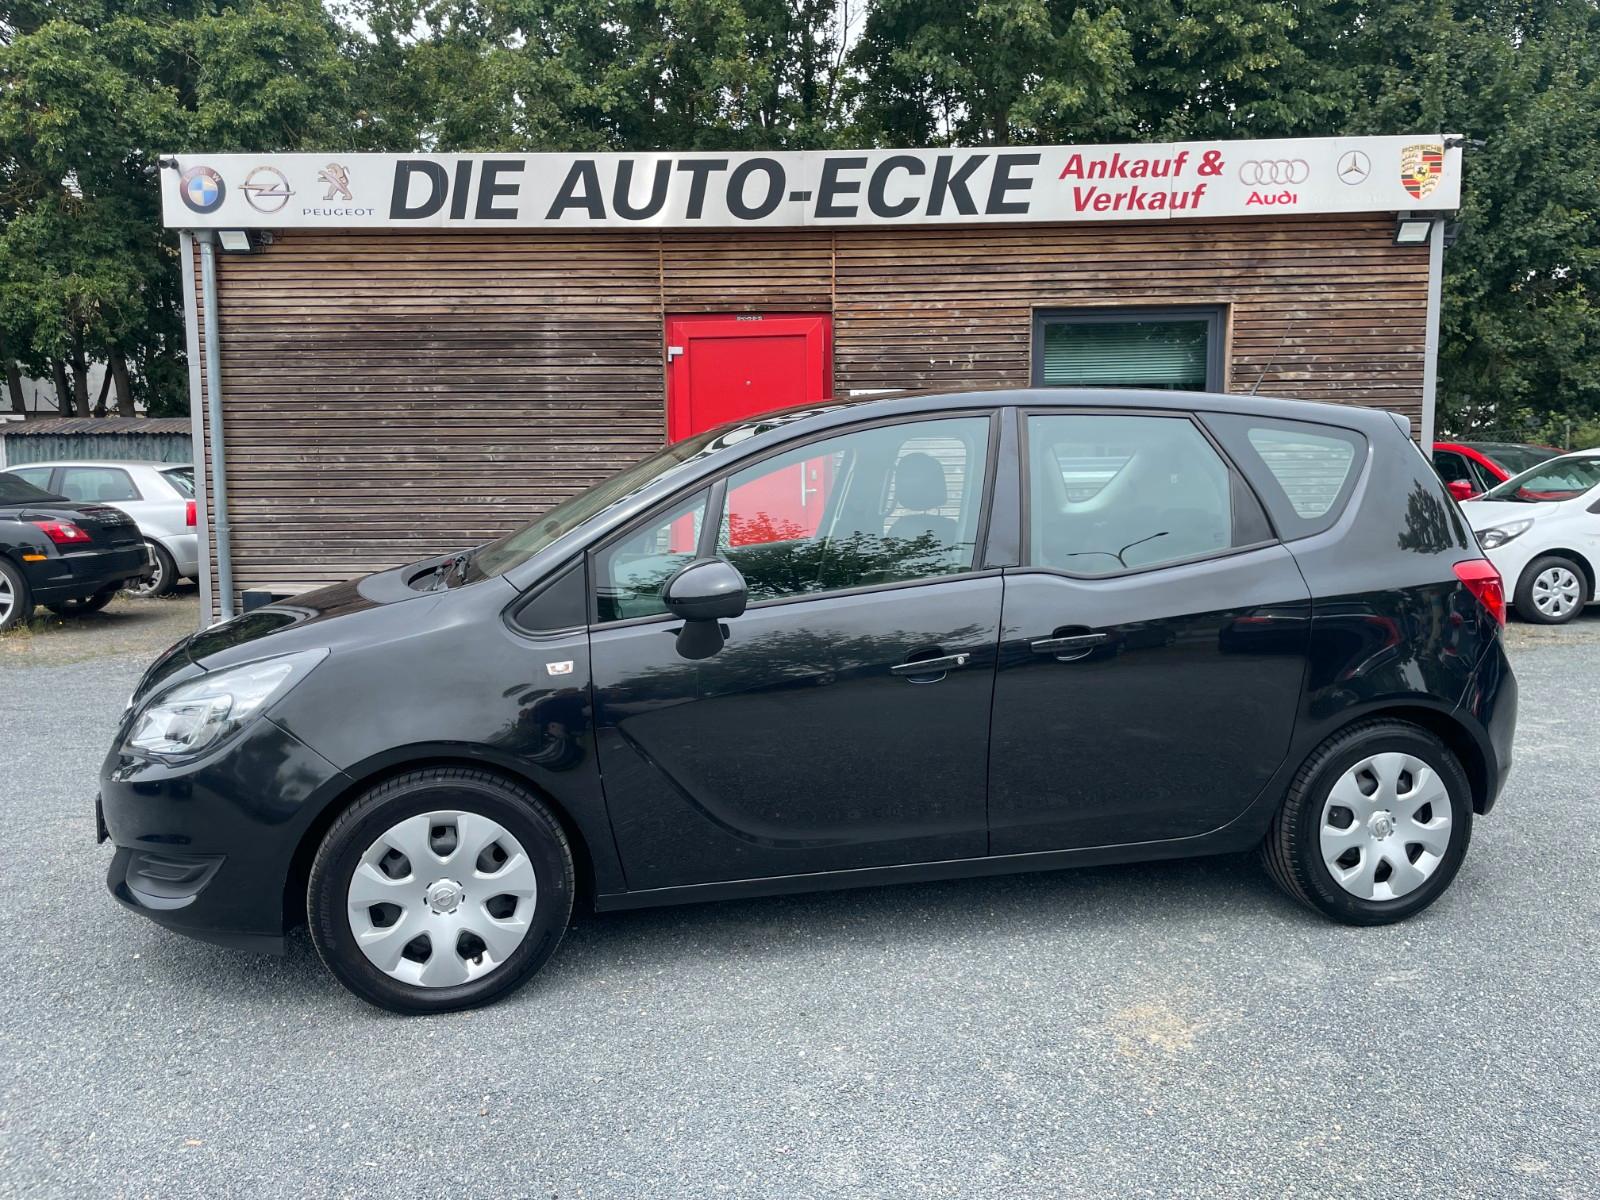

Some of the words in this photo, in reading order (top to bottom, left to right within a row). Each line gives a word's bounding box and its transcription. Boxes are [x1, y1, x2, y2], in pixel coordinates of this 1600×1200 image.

[1402, 144, 1443, 153] PORSCHE
[1058, 151, 1190, 180] Ankauf
[1197, 150, 1226, 177] &
[389, 159, 526, 220] DIE
[544, 153, 1041, 221] AUTO-ECKE
[1073, 183, 1208, 212] Verkauf
[1245, 191, 1298, 206] Audi
[302, 208, 375, 216] PEUGEOT
